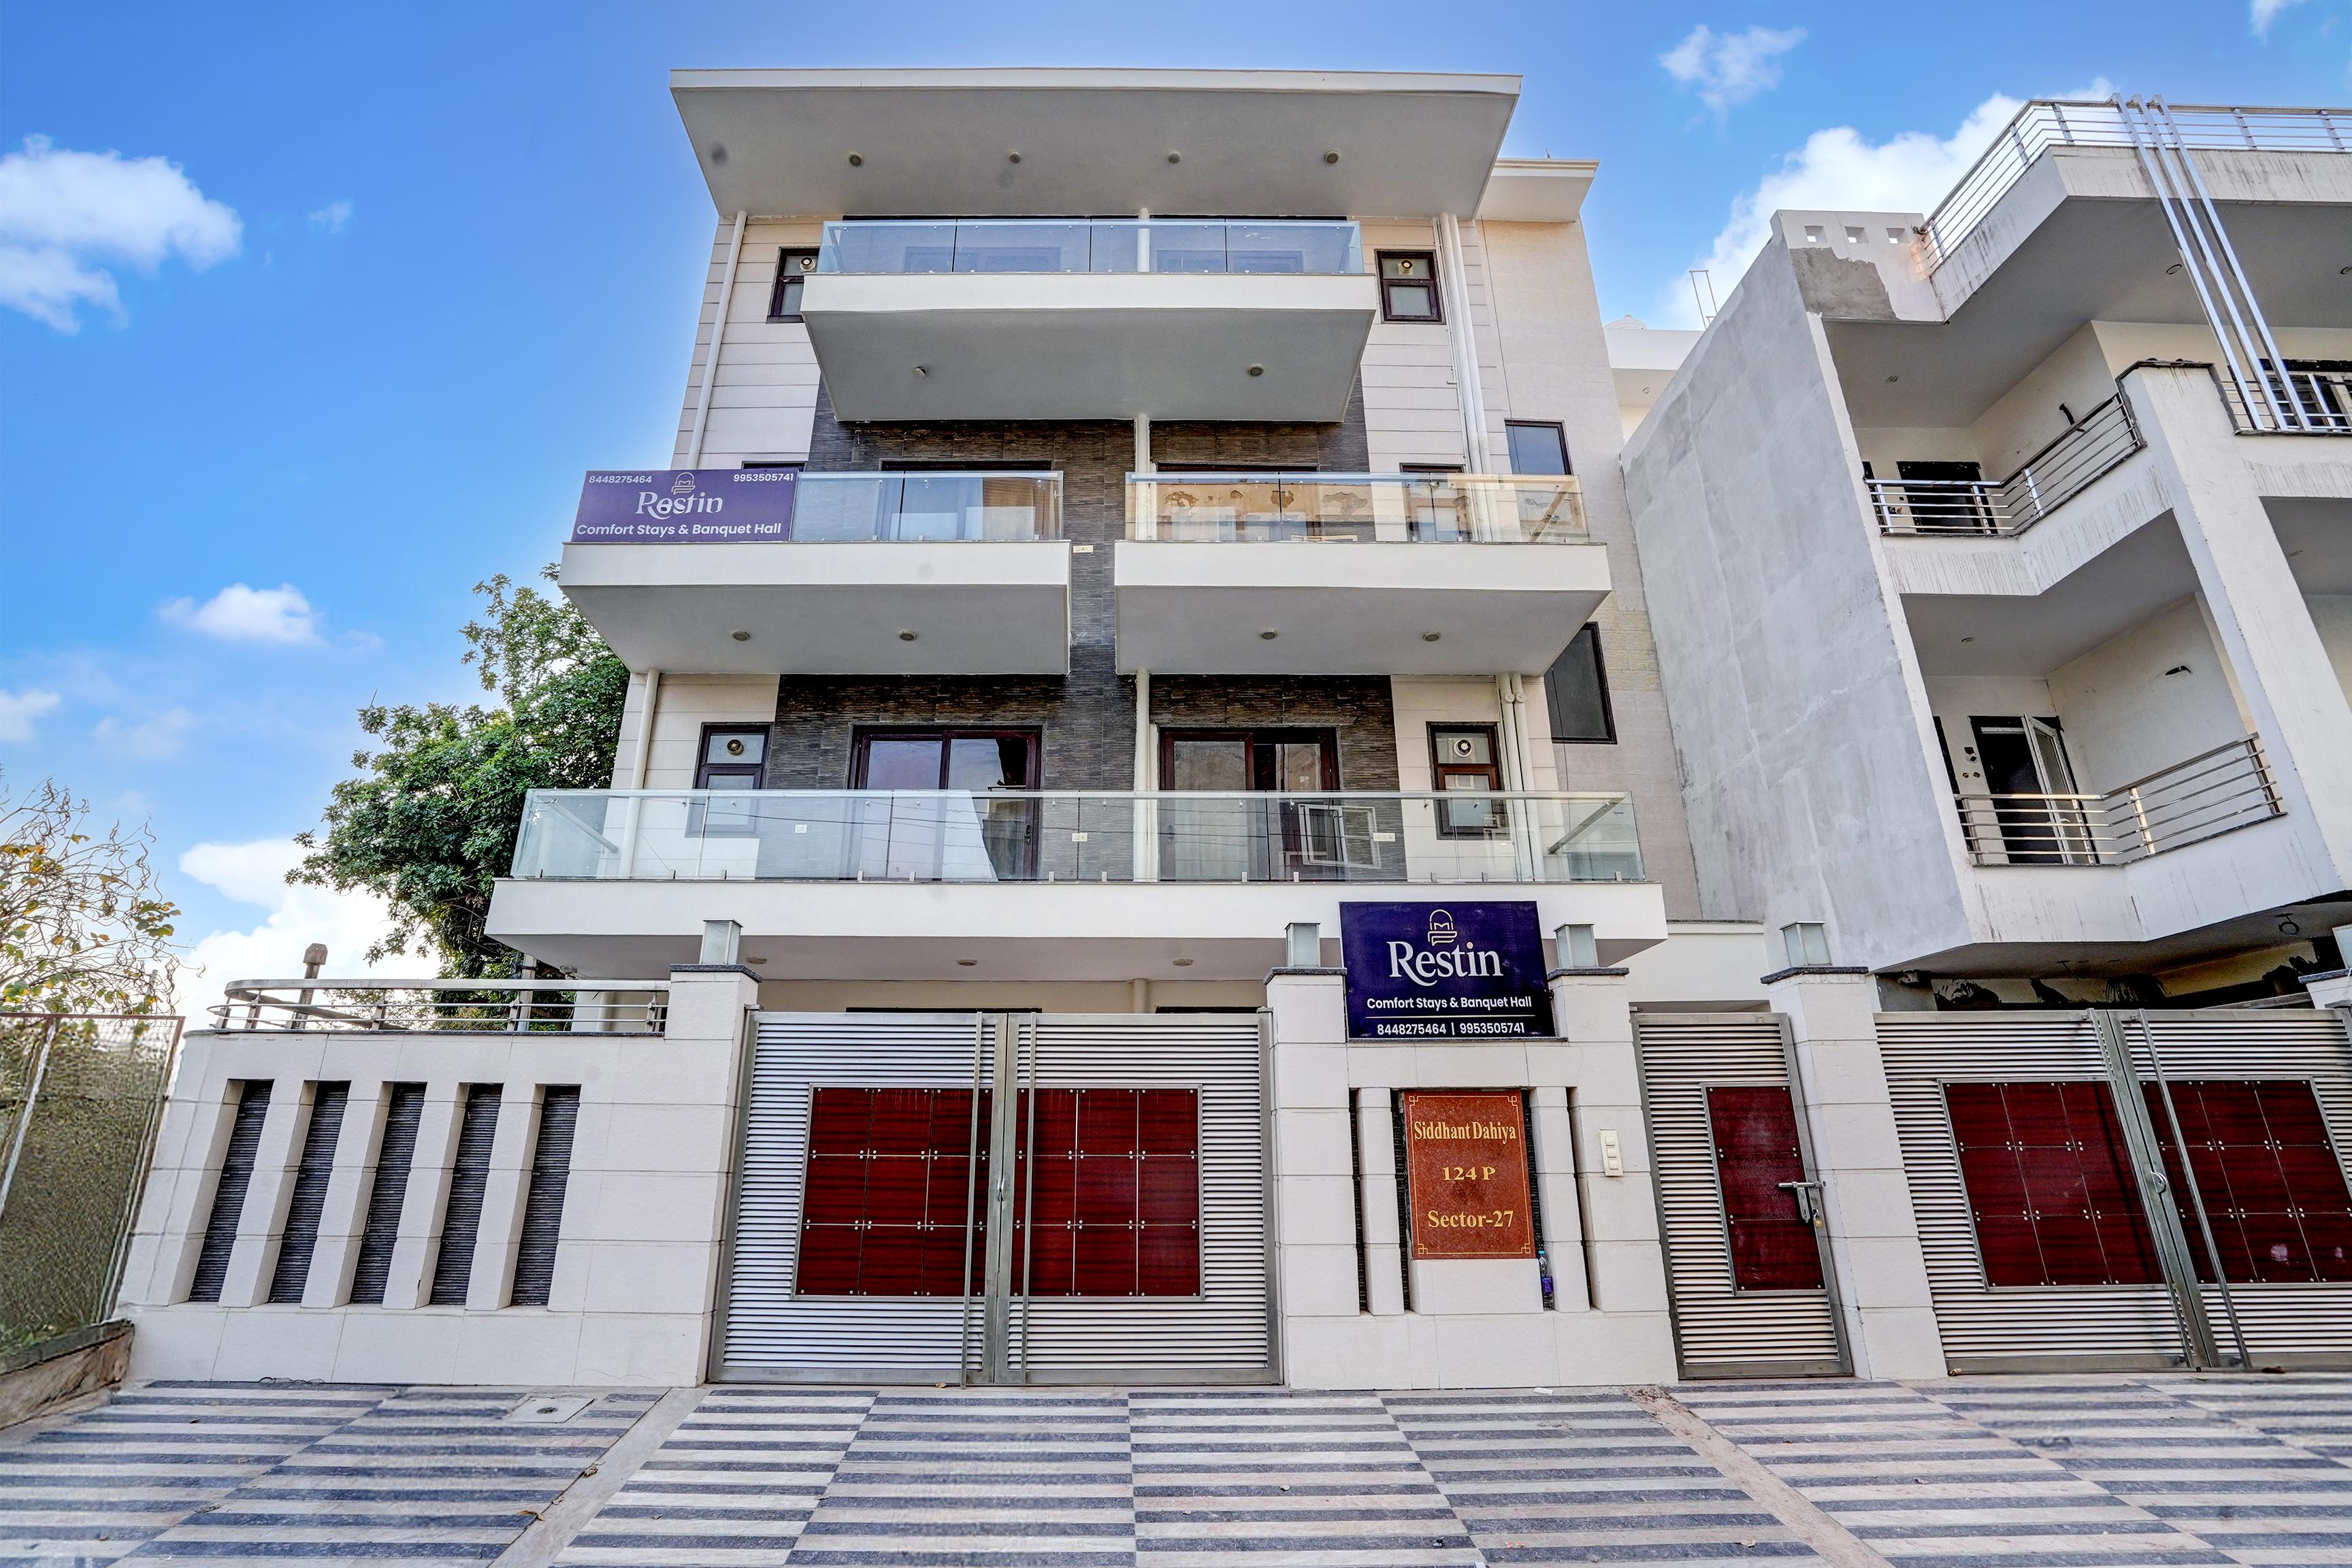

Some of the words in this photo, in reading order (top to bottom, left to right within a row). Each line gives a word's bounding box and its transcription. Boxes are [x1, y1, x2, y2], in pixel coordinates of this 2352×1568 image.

[589, 475, 652, 484] 8448275464
[733, 473, 794, 483] 9953505741
[634, 491, 723, 520] Restin
[576, 524, 634, 535] Comfort
[636, 524, 675, 538] Stays
[678, 524, 689, 535] &
[692, 524, 752, 537] Banquet
[755, 523, 782, 534] Hall
[1386, 941, 1503, 986] Restin
[1367, 997, 1414, 1009] Comfort
[1416, 997, 1448, 1011] Stays
[1450, 996, 1458, 1008] &
[1460, 996, 1508, 1011] Banquet
[1510, 996, 1532, 1008] Hall
[1377, 1023, 1446, 1035] 8448275464
[1460, 1022, 1525, 1034] 9953505741
[1414, 1121, 1471, 1140] Siddhant
[1472, 1121, 1516, 1145] Dahiya
[1441, 1166, 1477, 1181] 124
[1482, 1166, 1496, 1181] P
[1428, 1210, 1514, 1228] Sector-27
